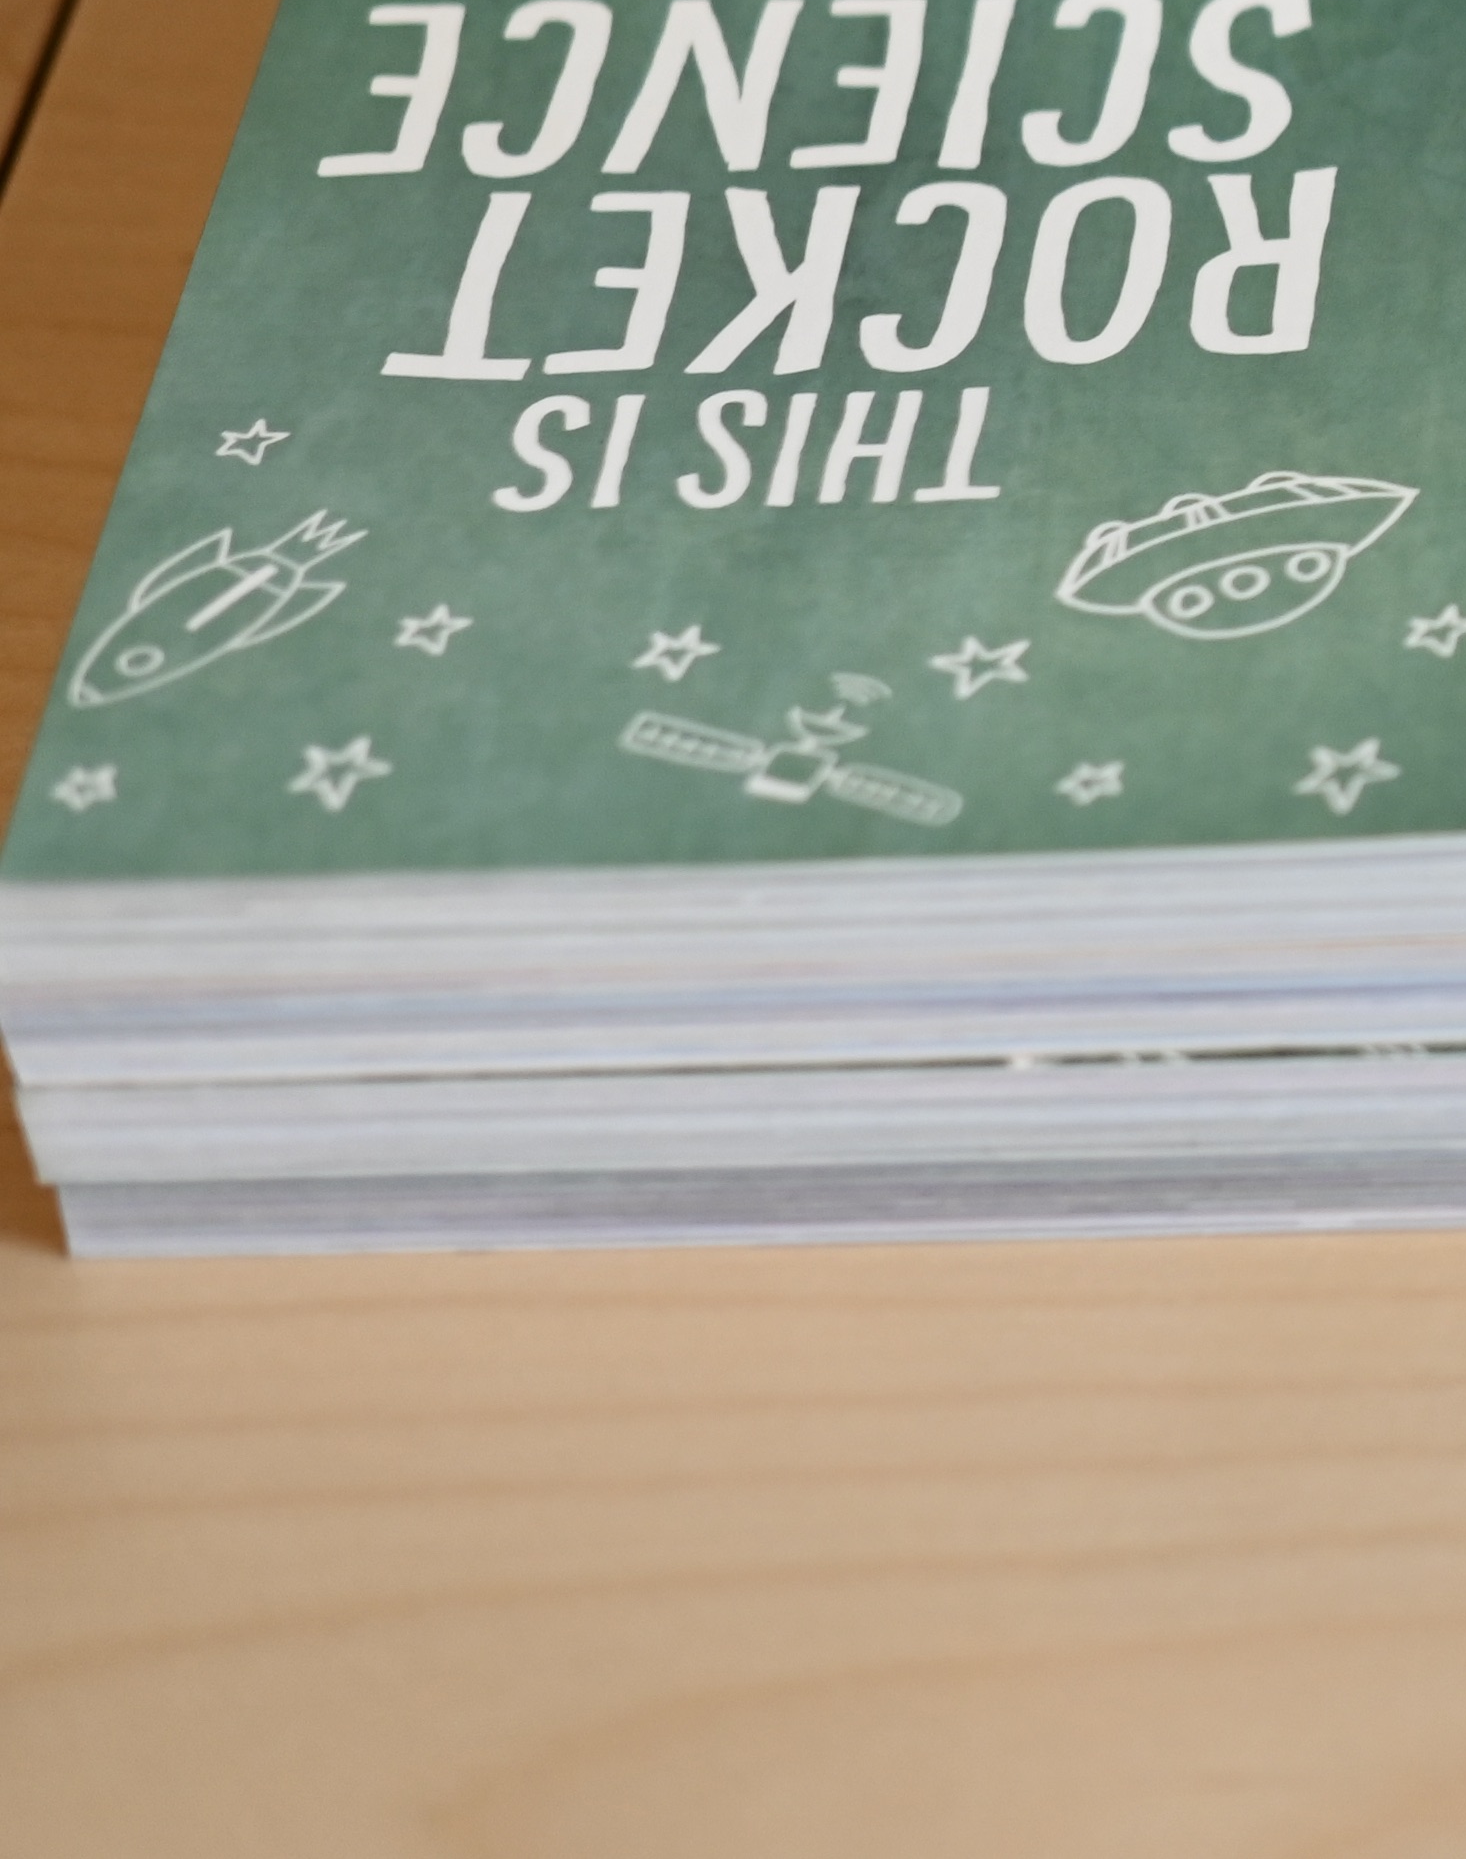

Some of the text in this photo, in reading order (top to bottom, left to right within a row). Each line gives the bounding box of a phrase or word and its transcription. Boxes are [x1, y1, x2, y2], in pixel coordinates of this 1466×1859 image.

[381, 166, 1338, 381] ROCKET
[492, 385, 1000, 512] THIS IS
